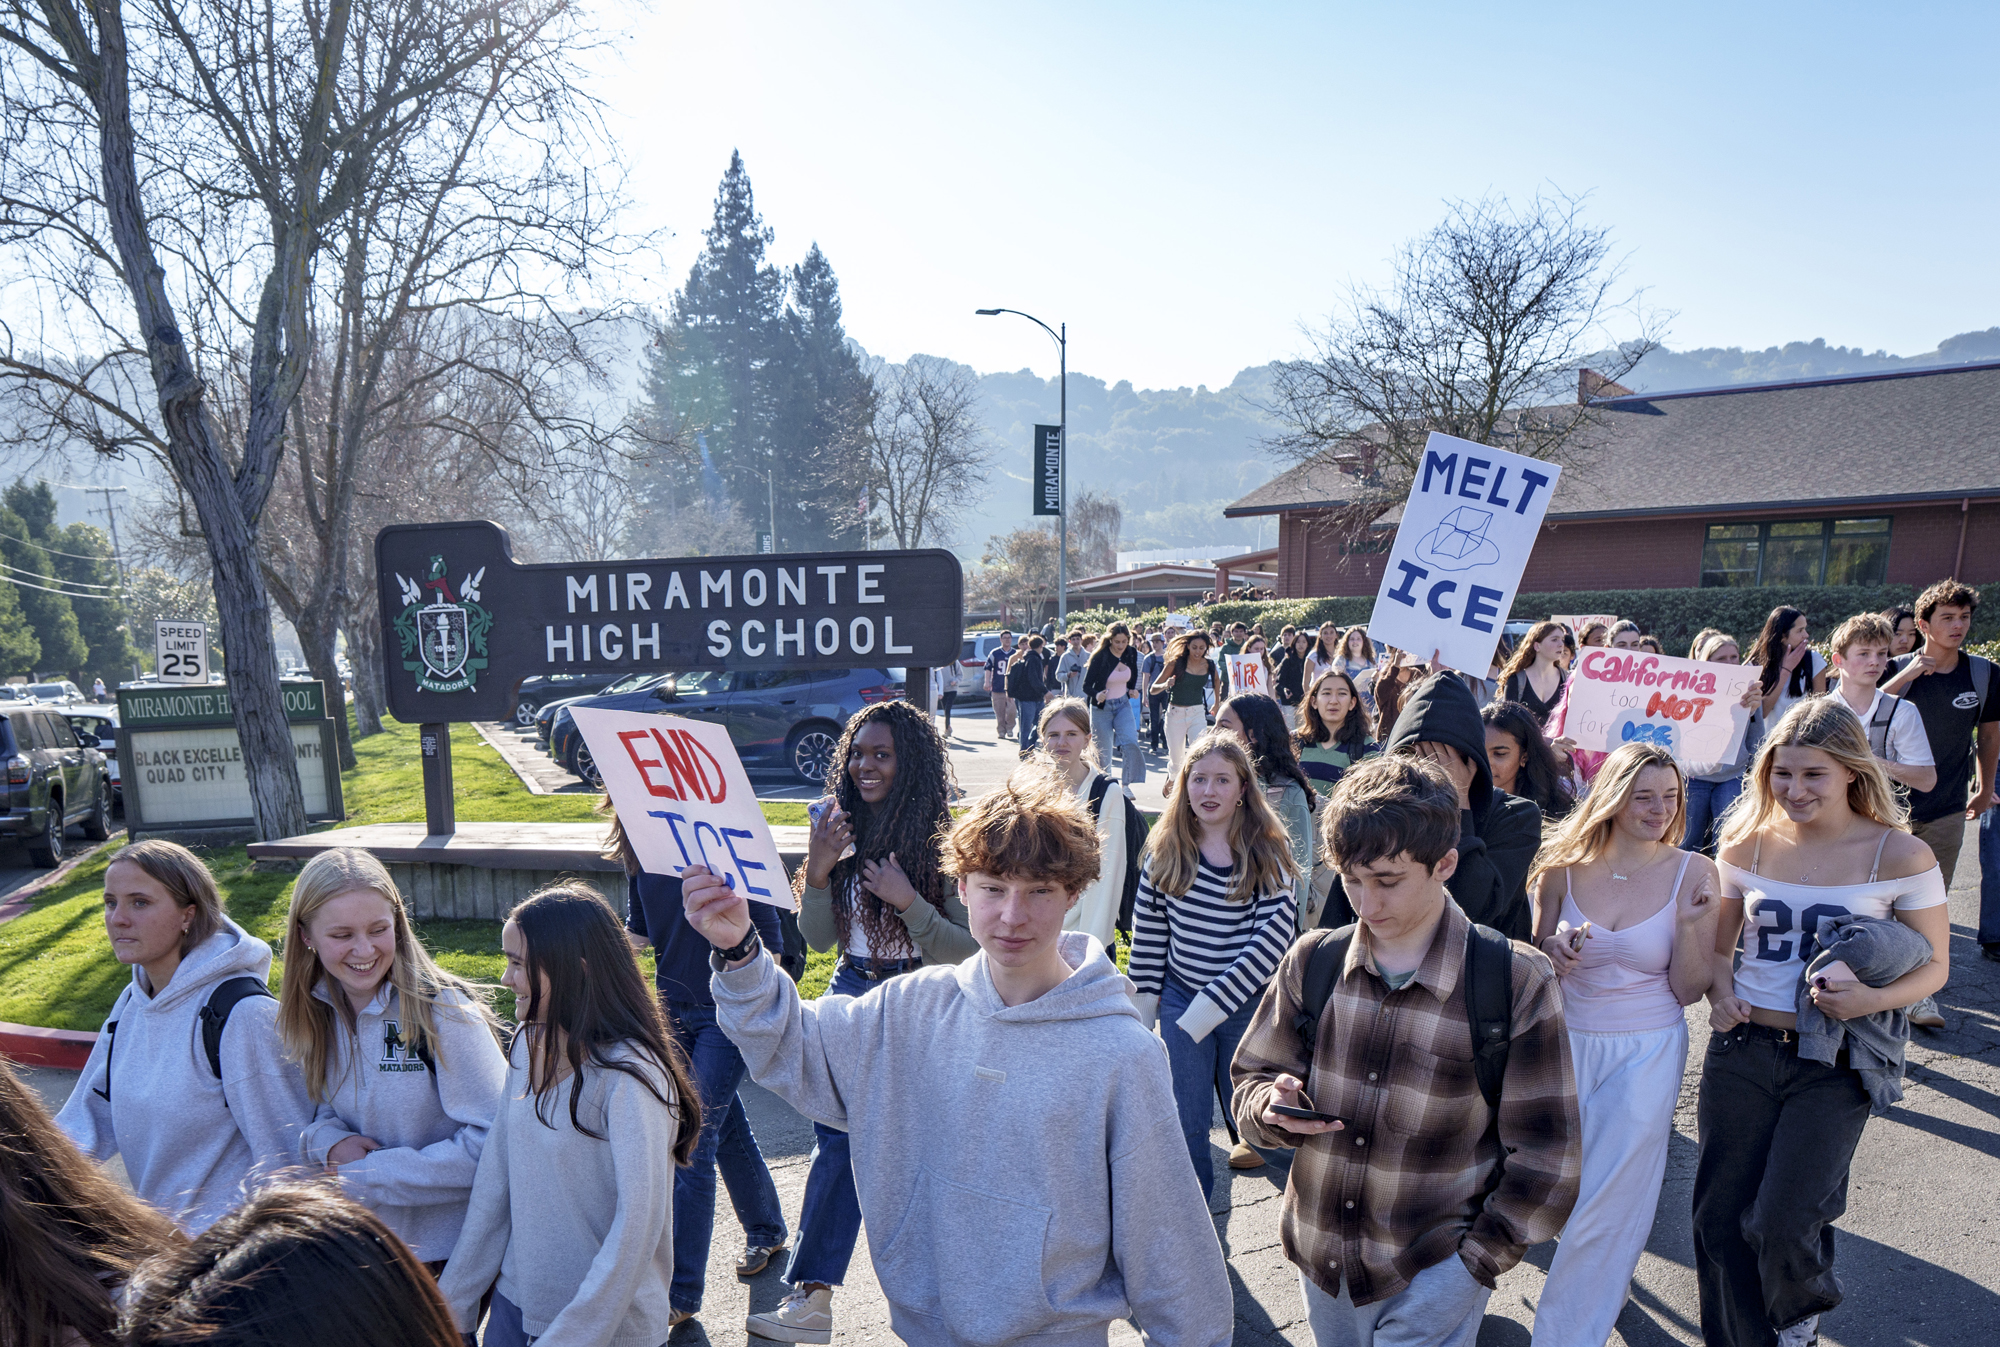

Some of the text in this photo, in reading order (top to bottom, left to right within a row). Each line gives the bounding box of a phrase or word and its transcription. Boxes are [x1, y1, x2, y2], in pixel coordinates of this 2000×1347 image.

[1045, 432, 1060, 509] MIRAMONTE
[1421, 450, 1549, 515] MELT
[566, 564, 885, 613] MIRAMONTE
[1387, 559, 1504, 634] ICE
[160, 627, 202, 638] SPEED
[166, 641, 197, 651] LIMIT
[546, 616, 913, 662] HIGH SCHOOL
[162, 654, 201, 677] 25
[1581, 651, 1746, 697] California is
[421, 678, 470, 691] MATADORS
[126, 694, 214, 719] MIRAMONTE
[1610, 688, 1714, 723] too HOT
[1577, 709, 1610, 735] for
[135, 750, 181, 767] BLACK
[185, 747, 241, 764] EXCELLE
[616, 728, 727, 804] END
[147, 765, 226, 784] QUAD CITY
[646, 811, 772, 897] ICE
[379, 1063, 425, 1072] MATADORS
